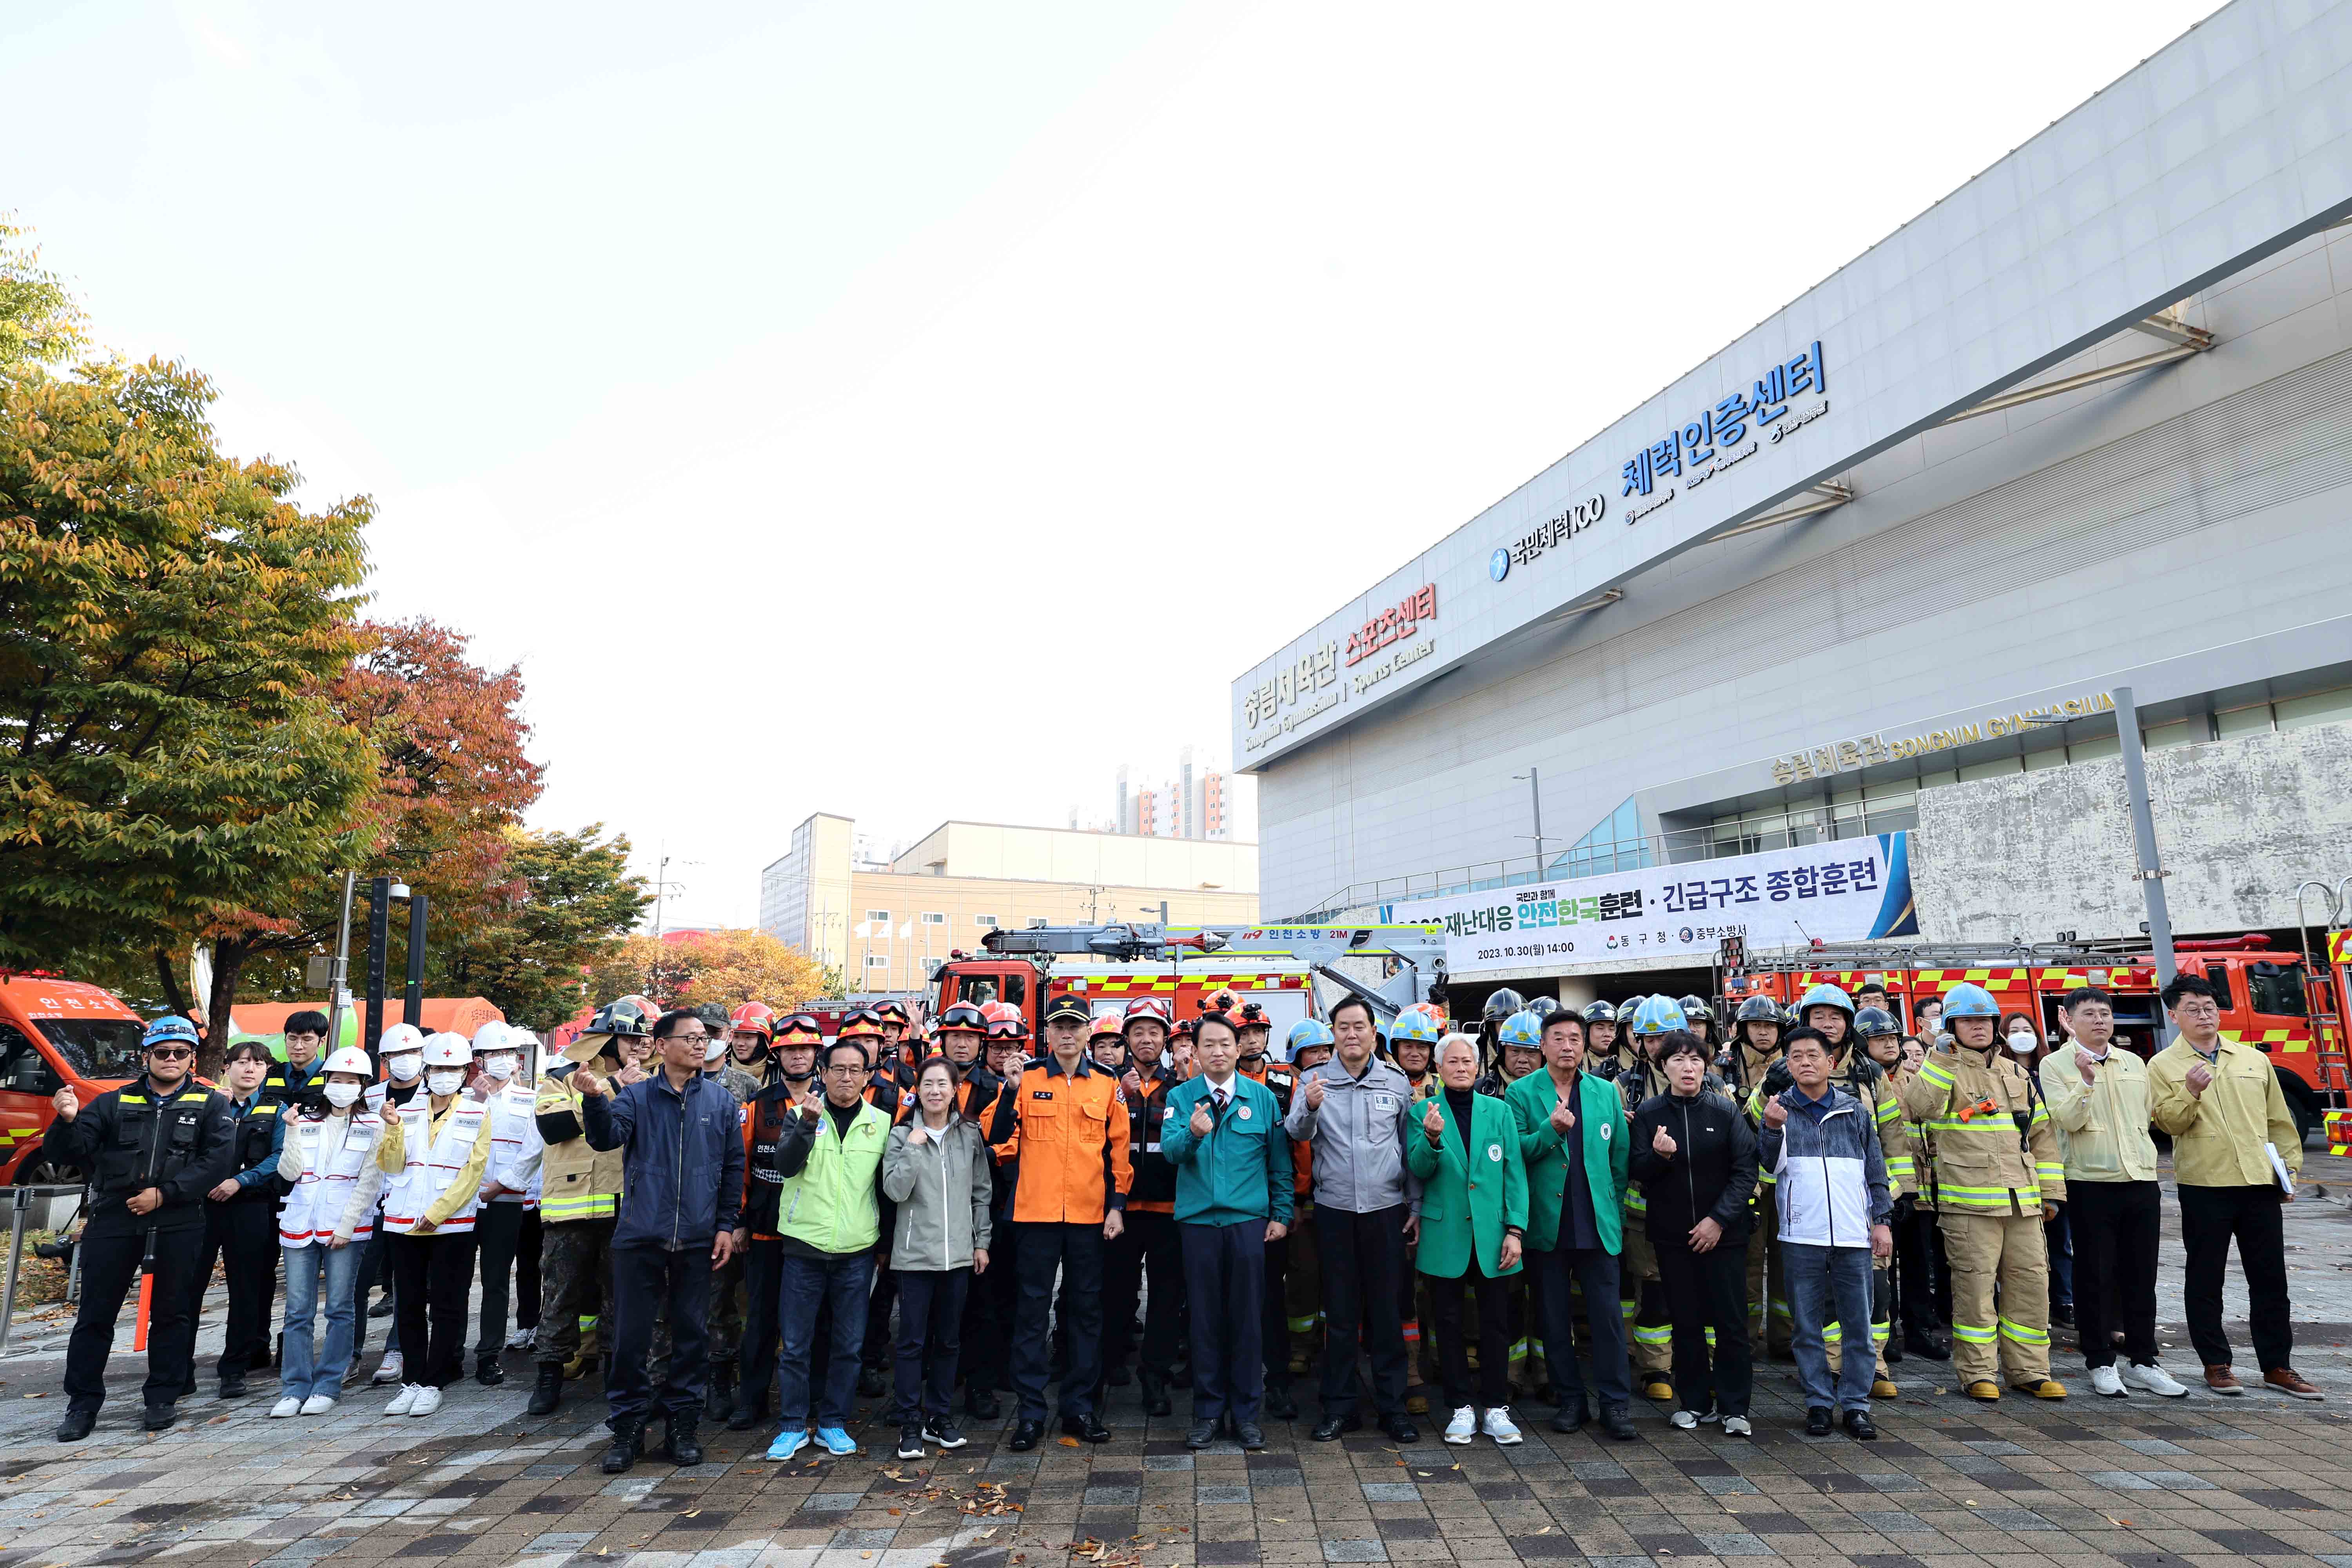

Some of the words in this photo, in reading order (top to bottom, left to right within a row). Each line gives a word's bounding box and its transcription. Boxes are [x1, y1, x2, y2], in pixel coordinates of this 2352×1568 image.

[1621, 340, 1826, 497] 체력인증센터
[1686, 467, 1714, 489] KSPO
[1245, 640, 1337, 730] 송림체육관
[1345, 583, 1436, 667] 스포츠센터
[1283, 692, 1338, 732] Gymnasium
[1354, 662, 1390, 695] Sports
[1392, 639, 1434, 671] Center
[1770, 733, 1889, 785] 송림체육관
[1889, 722, 1982, 759] SONGNIM
[1445, 906, 1514, 937] 재난대응
[1517, 889, 1643, 929] 안전한국훈련
[1663, 876, 1760, 913] 긴급구조
[1766, 857, 1878, 902] 종합훈련
[1516, 892, 1538, 902] 국민과
[1540, 889, 1555, 900] 함께
[1242, 930, 1263, 940] 119
[1330, 930, 1348, 938] 21M
[1696, 924, 1747, 940] 중부소방서
[1547, 942, 1574, 953] 14:00
[1791, 1204, 1803, 1224] LAB
